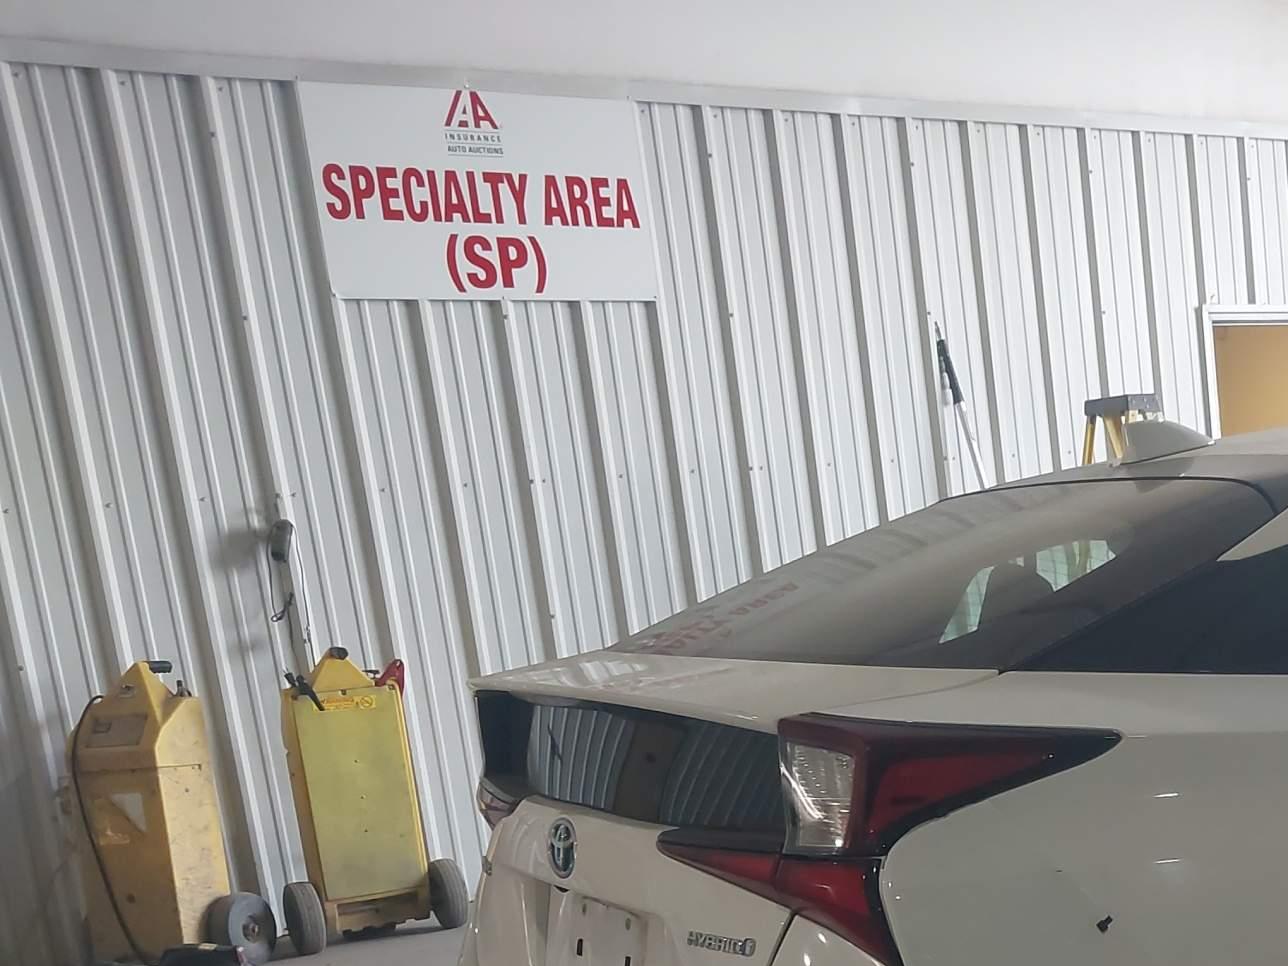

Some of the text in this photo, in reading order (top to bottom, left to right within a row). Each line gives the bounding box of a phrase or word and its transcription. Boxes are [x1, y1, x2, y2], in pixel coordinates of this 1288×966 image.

[444, 132, 502, 143] INSURANCE
[447, 145, 504, 155] AUTO AUCTIONS
[322, 163, 641, 229] SPECIALTY AREA
[445, 234, 548, 293] (SP)
